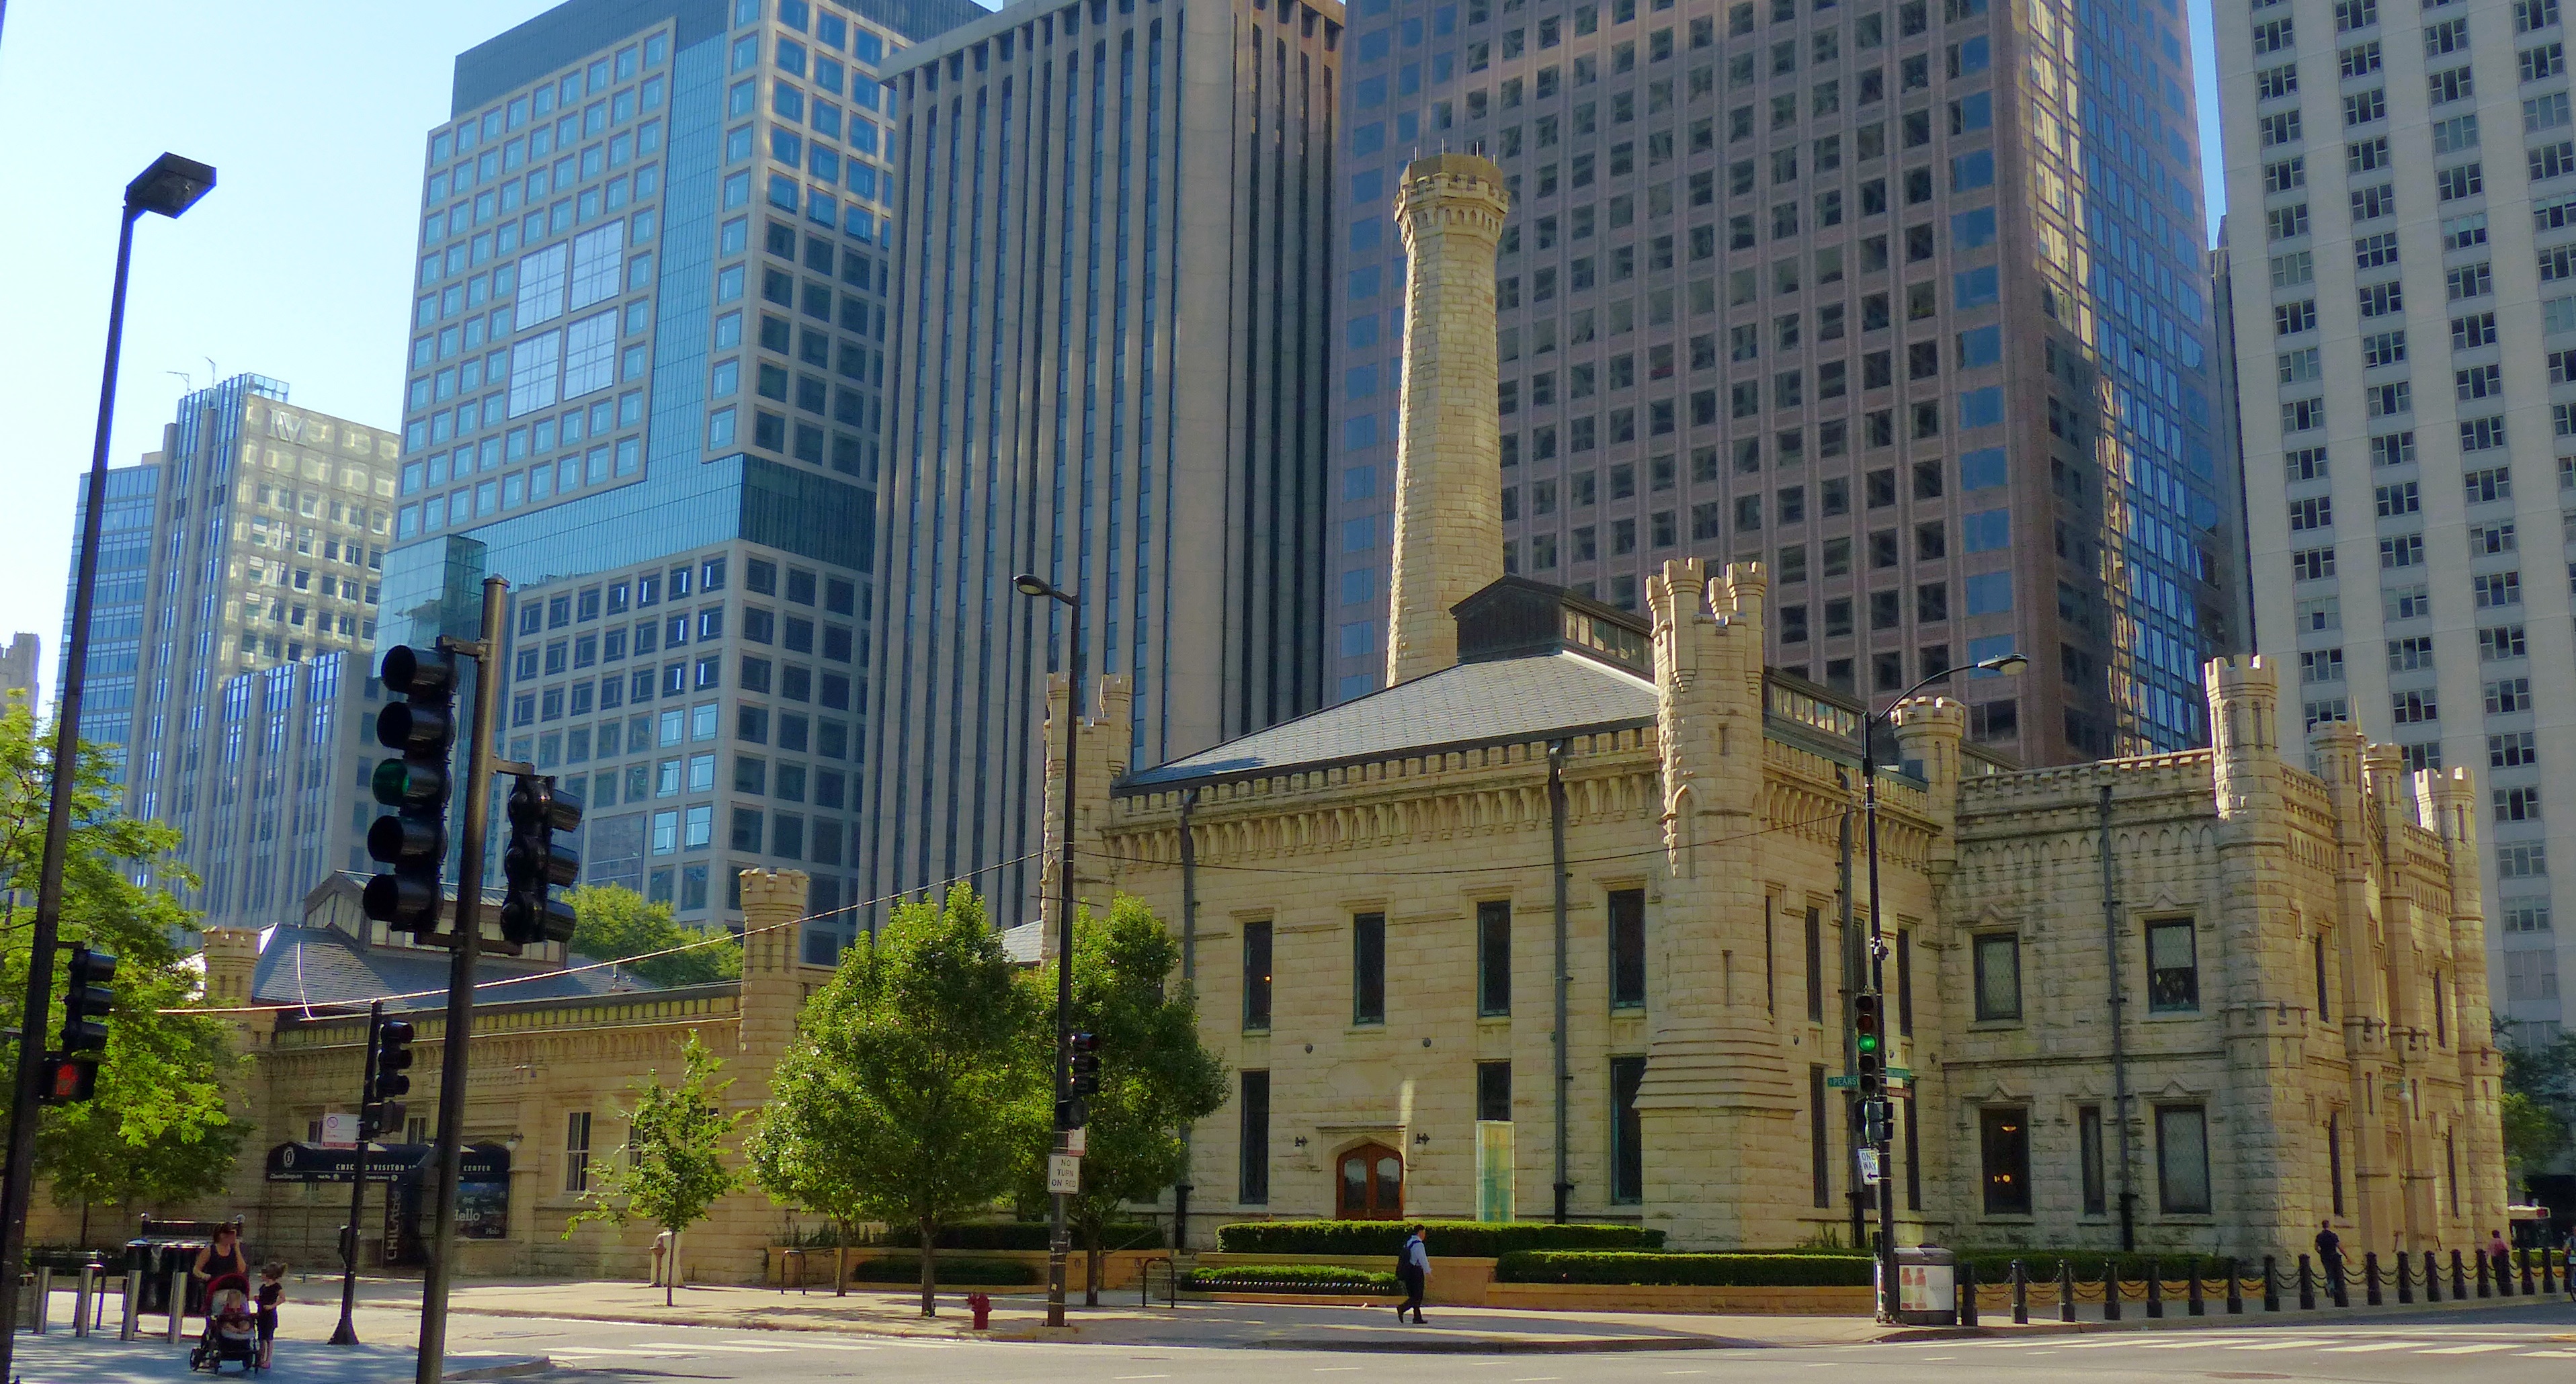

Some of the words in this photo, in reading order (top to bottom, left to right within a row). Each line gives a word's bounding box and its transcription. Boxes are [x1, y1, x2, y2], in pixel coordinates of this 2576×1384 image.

[1833, 1077, 1857, 1086] PEARS
[1861, 1152, 1876, 1161] ONE
[1863, 1162, 1876, 1170] WAY
[1057, 1168, 1074, 1177] TURN
